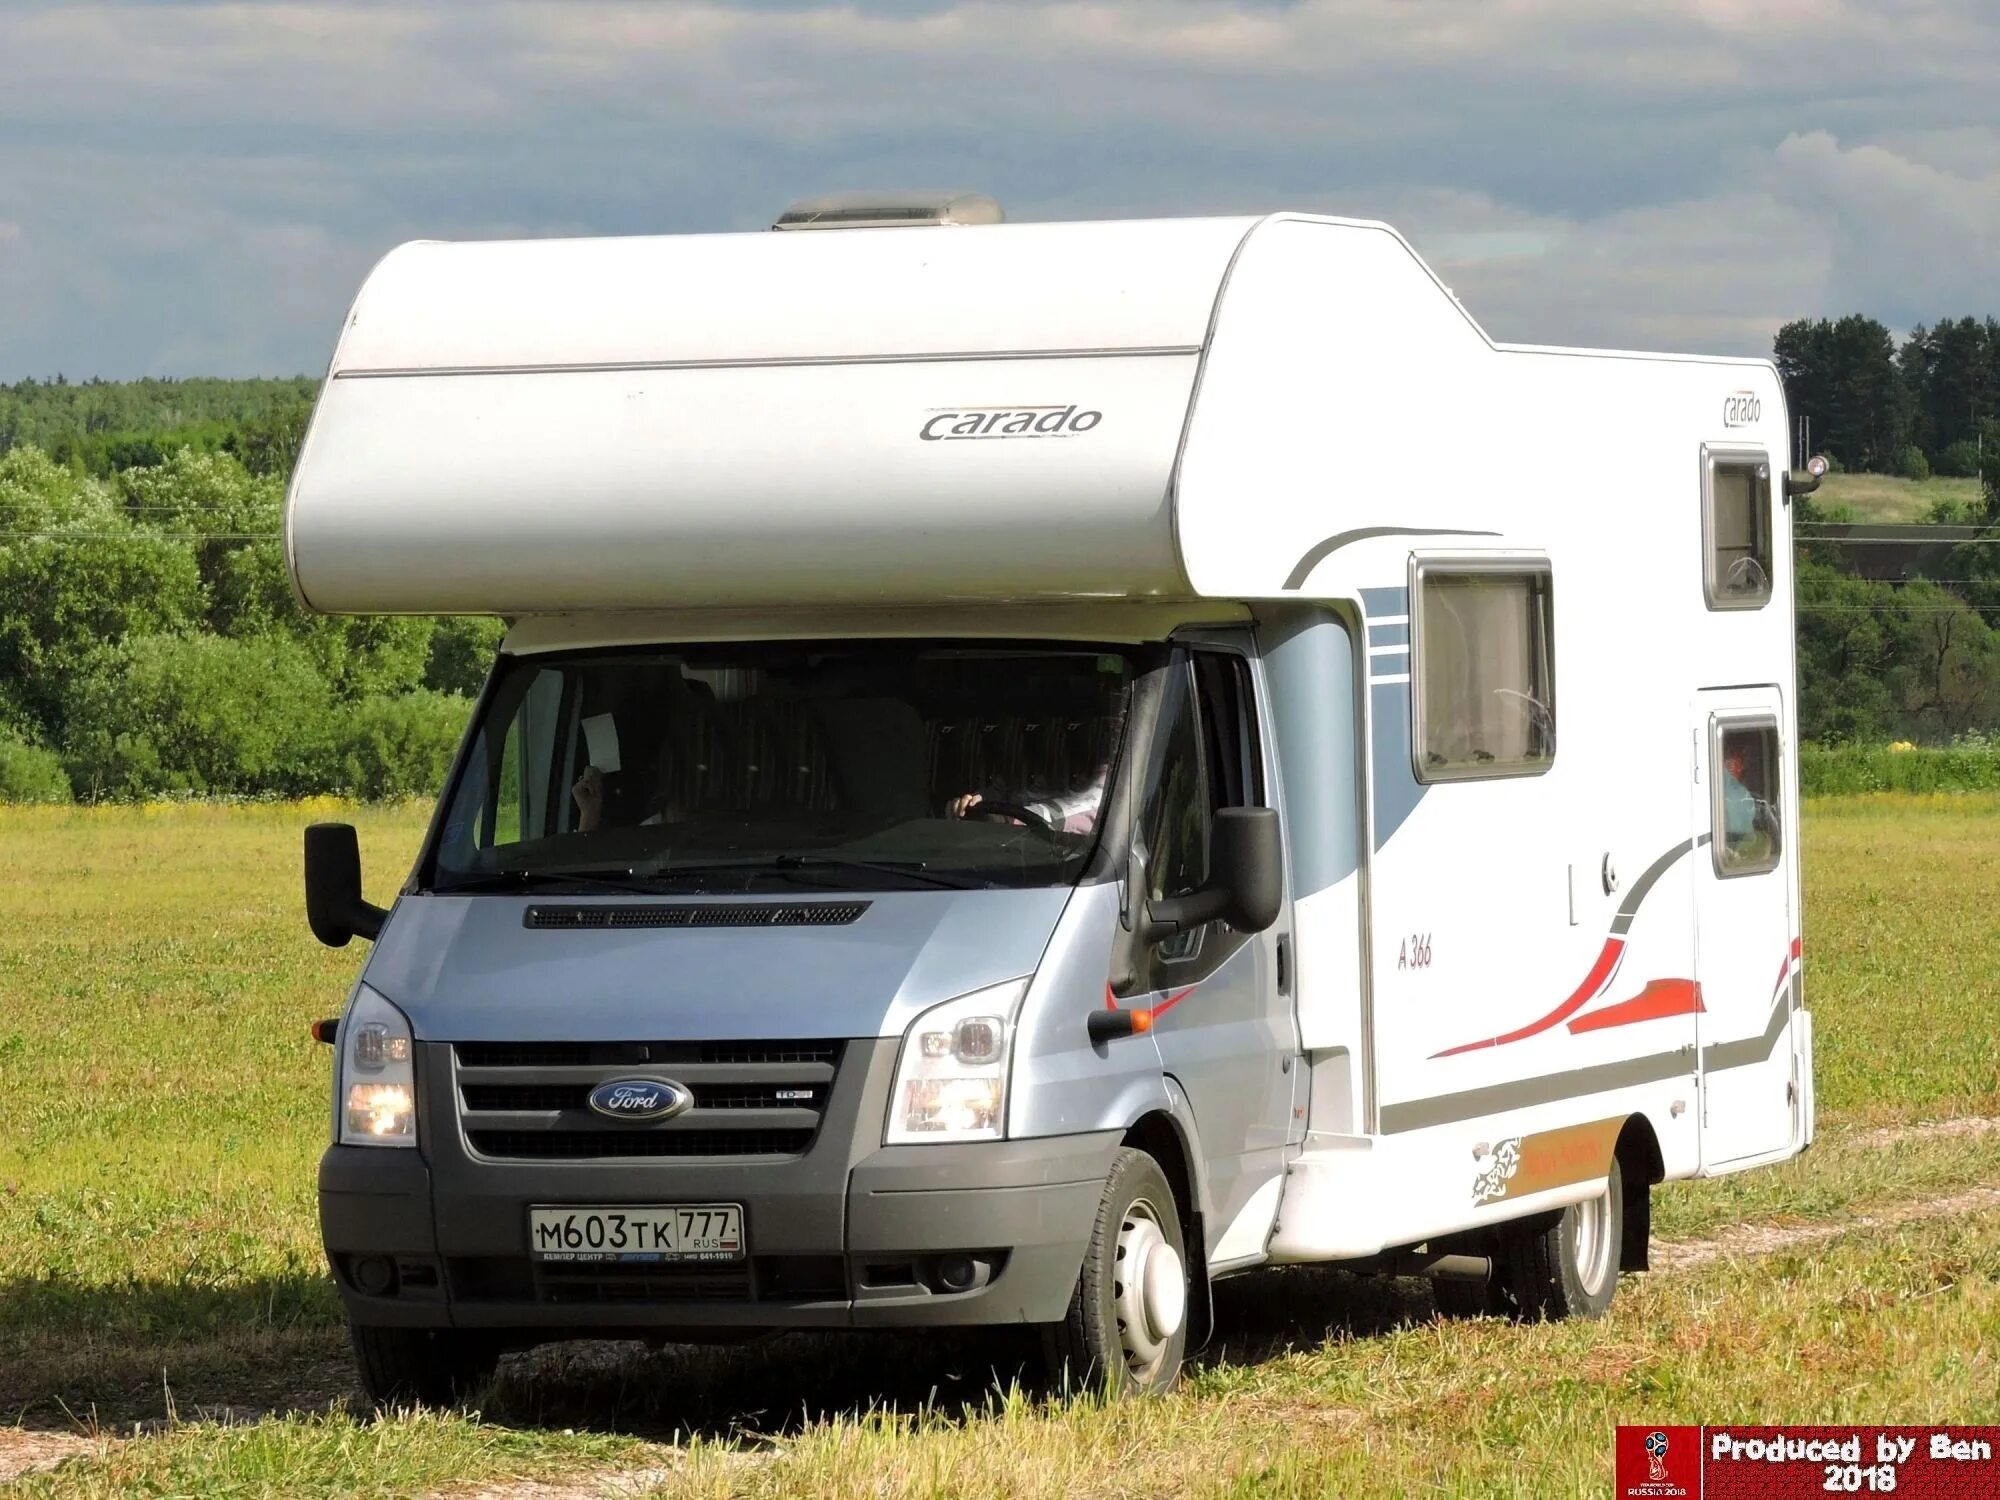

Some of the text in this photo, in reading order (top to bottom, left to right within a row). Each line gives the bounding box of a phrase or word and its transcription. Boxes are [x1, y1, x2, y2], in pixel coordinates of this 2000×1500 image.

[919, 404, 1103, 441] carado
[1723, 391, 1761, 428] carado
[1397, 931, 1432, 971] A 366
[608, 1086, 657, 1109] Ford
[679, 1211, 729, 1238] 777
[576, 1253, 603, 1262] ЦЕНТР
[693, 1239, 719, 1249] RUS
